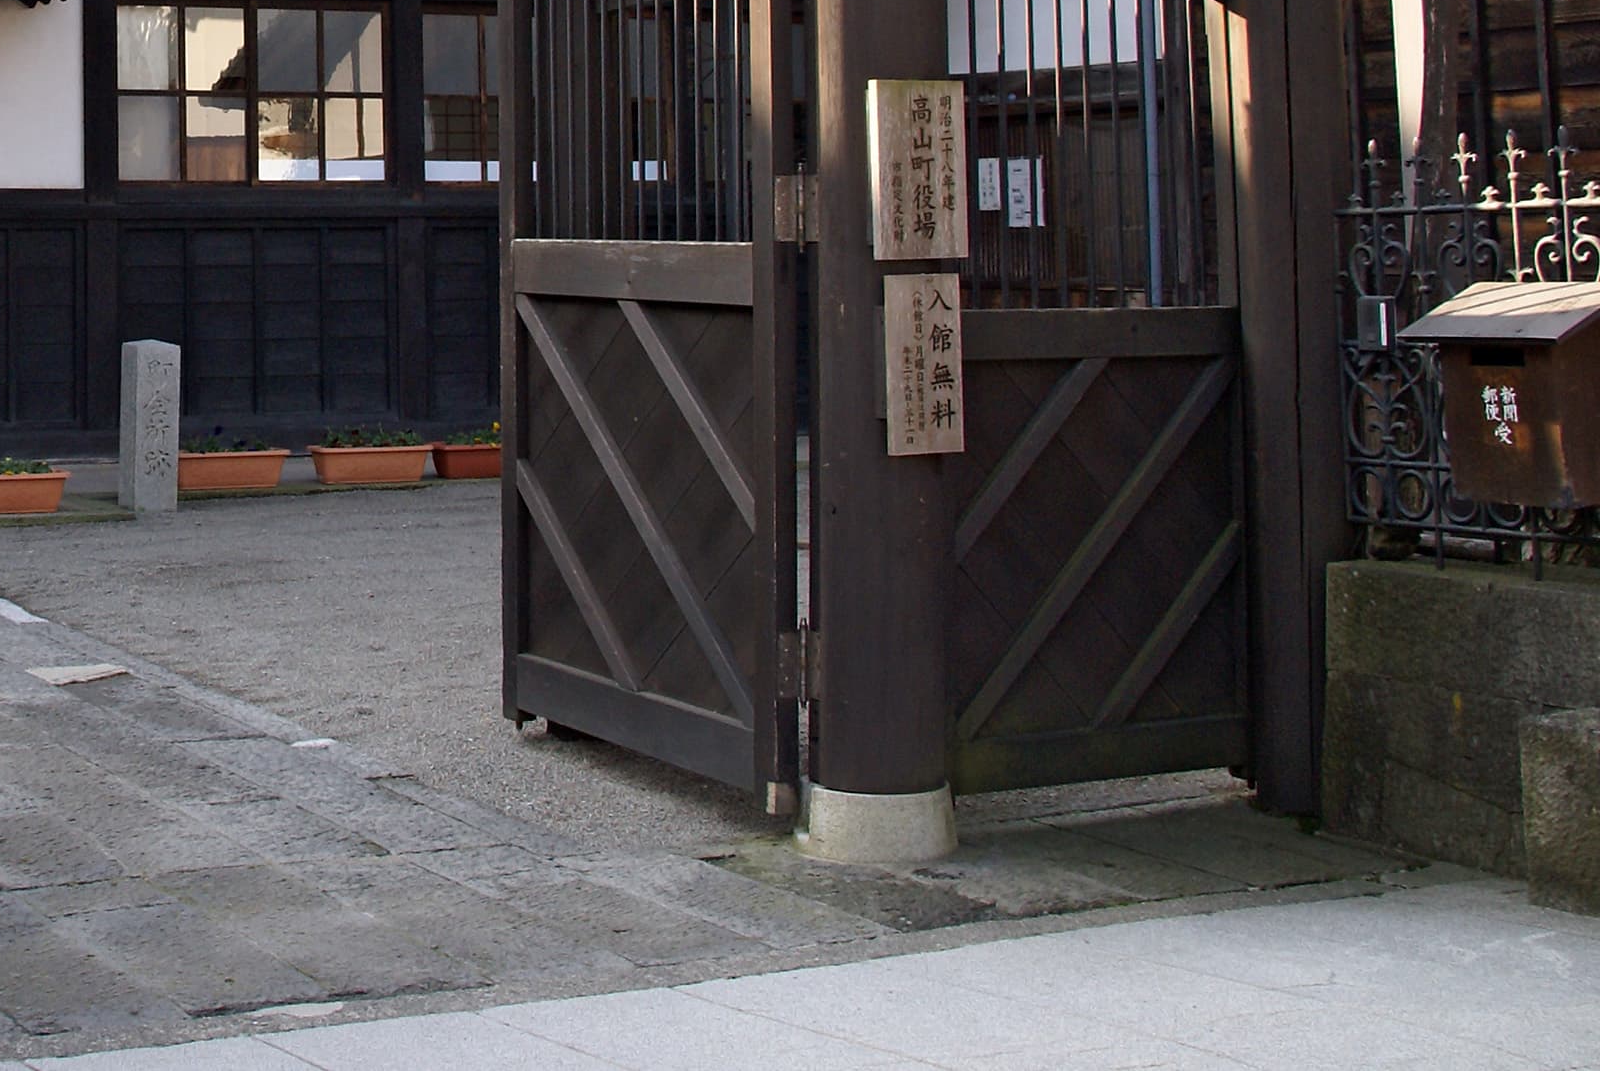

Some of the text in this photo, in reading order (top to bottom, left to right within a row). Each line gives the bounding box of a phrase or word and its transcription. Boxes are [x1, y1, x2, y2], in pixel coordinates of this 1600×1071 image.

[911, 93, 937, 241] 高山町役場
[939, 94, 956, 212] 明治二十八年建
[927, 289, 957, 430] 入館無料
[1481, 385, 1501, 421] 郵便
[1494, 421, 1513, 445] 受
[1500, 385, 1518, 423] 新聞
